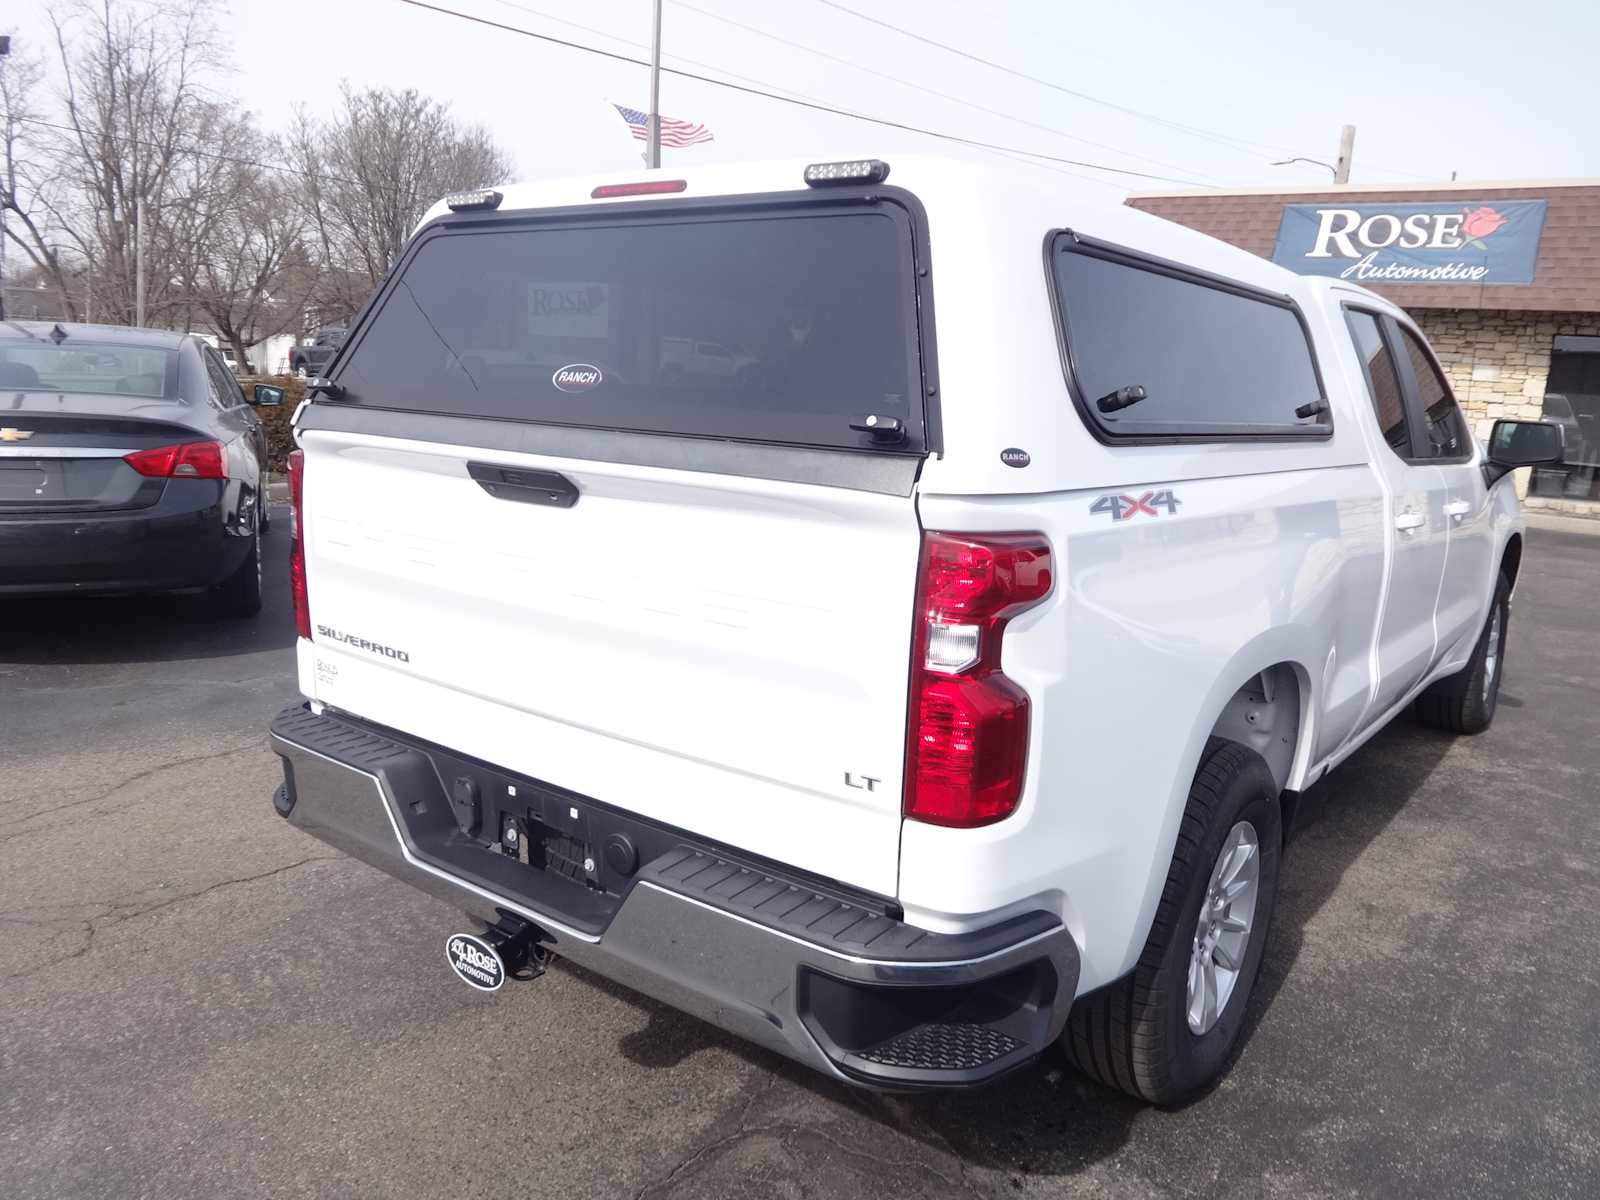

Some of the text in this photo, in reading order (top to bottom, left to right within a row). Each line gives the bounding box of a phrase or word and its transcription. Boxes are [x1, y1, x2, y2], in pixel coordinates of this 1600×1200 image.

[1305, 209, 1464, 258] ROSE
[1340, 251, 1488, 280] Automotive
[558, 371, 597, 384] RANCH
[1002, 452, 1030, 462] RANCH
[317, 624, 409, 662] SILVERADO
[844, 772, 882, 792] LT
[466, 944, 497, 973] ROSE
[456, 960, 495, 985] AUTOMOTIVE
